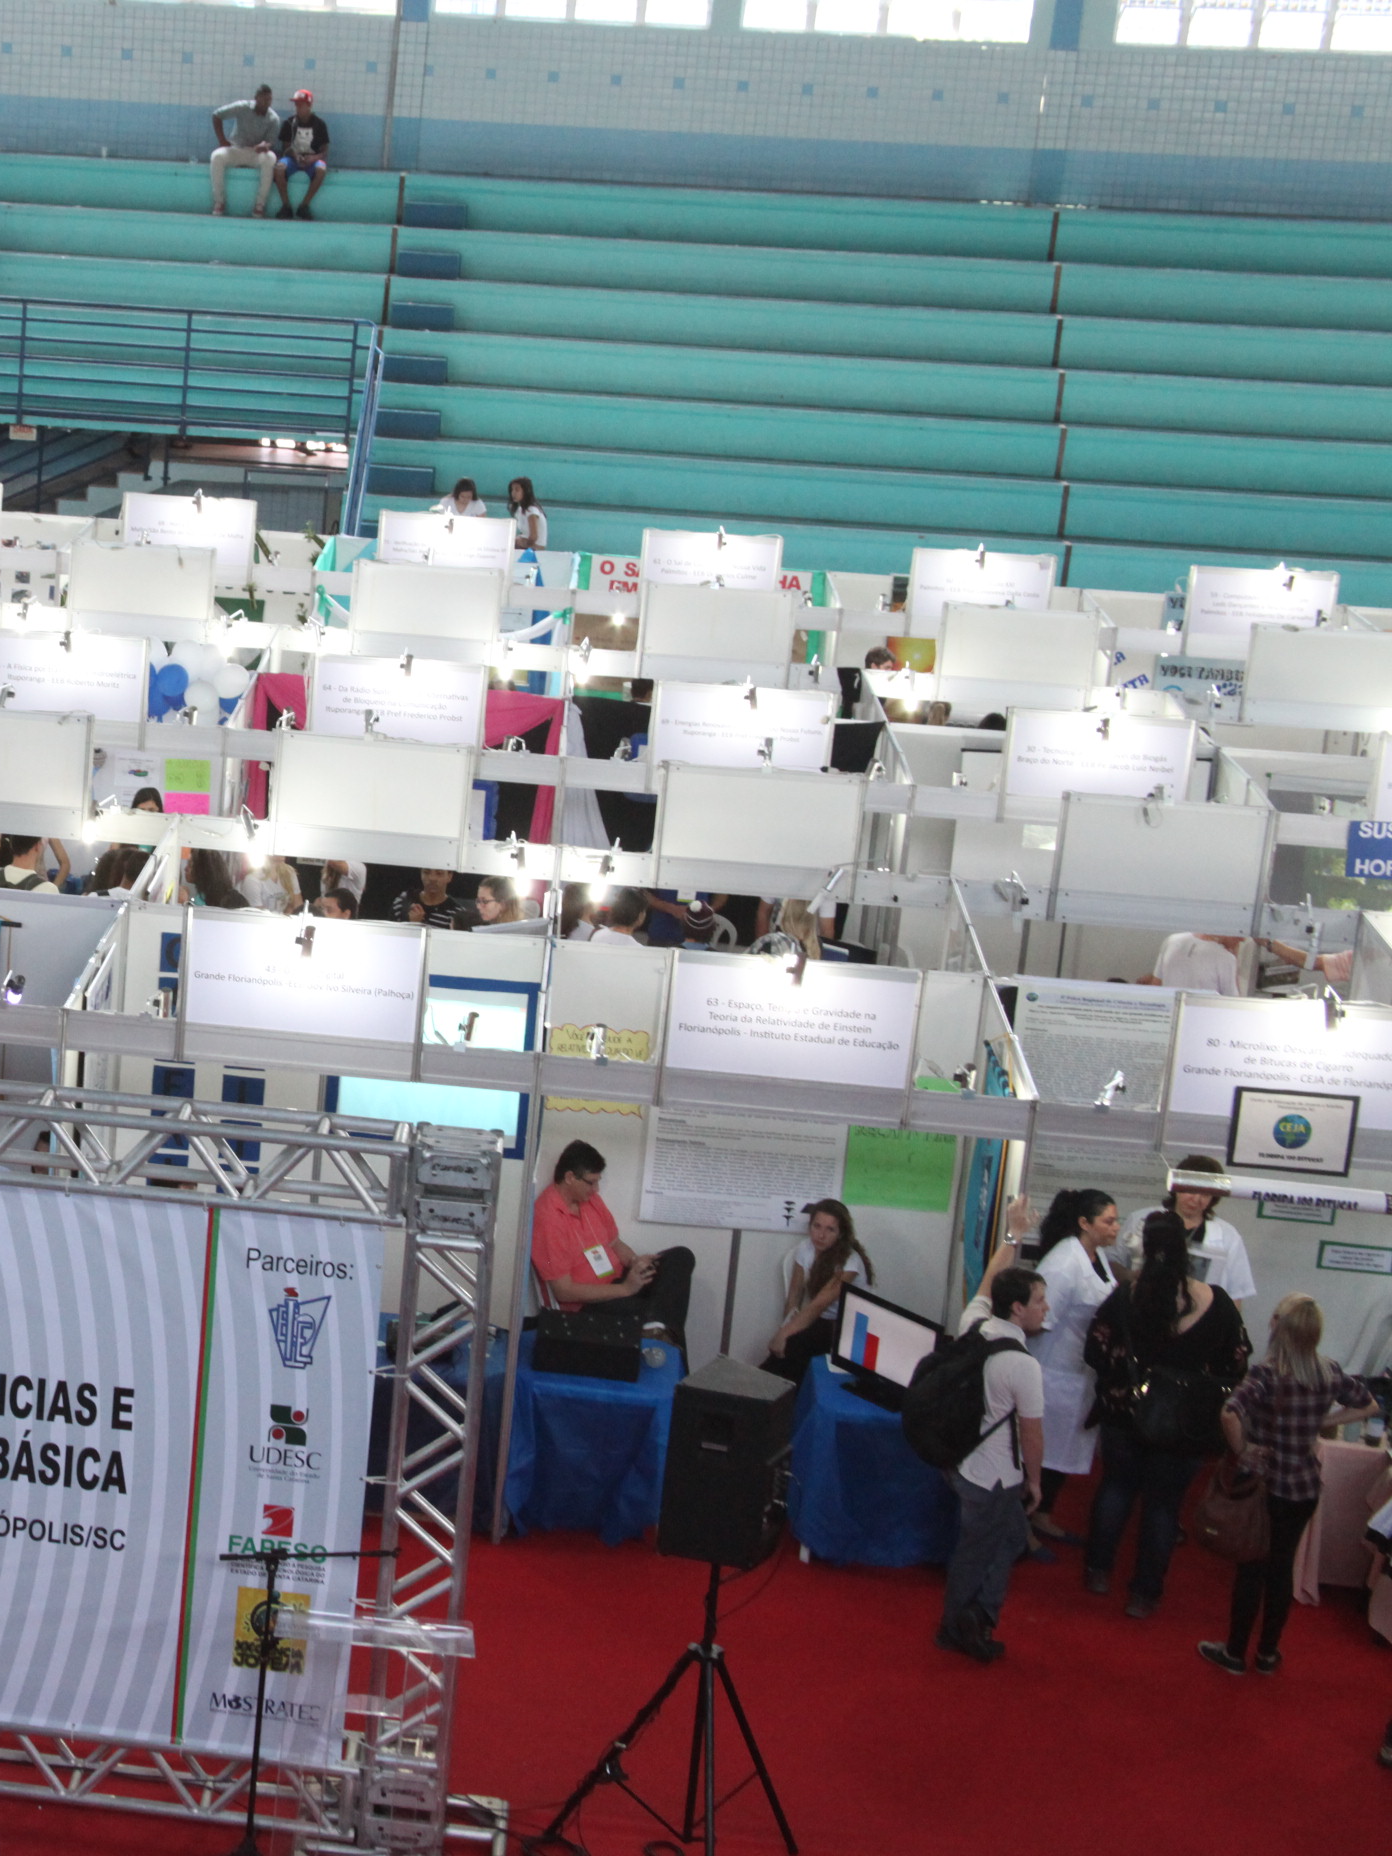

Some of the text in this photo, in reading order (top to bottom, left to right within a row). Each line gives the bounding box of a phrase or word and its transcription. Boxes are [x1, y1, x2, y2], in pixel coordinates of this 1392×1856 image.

[599, 559, 616, 576] O
[325, 705, 366, 716] Ituporang
[194, 970, 226, 981] Grande
[227, 973, 283, 988] Florianópolis
[341, 984, 372, 996] Silveira
[374, 986, 415, 1000] (Palhoça)
[706, 997, 719, 1007] 63
[727, 998, 764, 1013] Espaço,
[768, 1002, 802, 1015] Temo
[811, 1006, 862, 1019] Gravidade
[864, 1012, 877, 1021] na
[708, 1011, 872, 1034] Teoria da Relatividade de Einstein
[678, 1022, 900, 1052] Florianópolis Instituto Estadual de Educação
[1206, 1037, 1280, 1053] 80 Microlixo:
[1183, 1064, 1222, 1077] Grande
[1224, 1067, 1291, 1083] Florianópolis
[1300, 1073, 1325, 1085] CEJA
[1327, 1076, 1341, 1086] de
[1243, 1056, 1354, 1074] de Bitucas de Cigarro
[1279, 1121, 1307, 1134] CEJA
[245, 1247, 356, 1281] Parceiros:
[110, 1386, 136, 1432] E
[248, 1445, 323, 1471] UDESC
